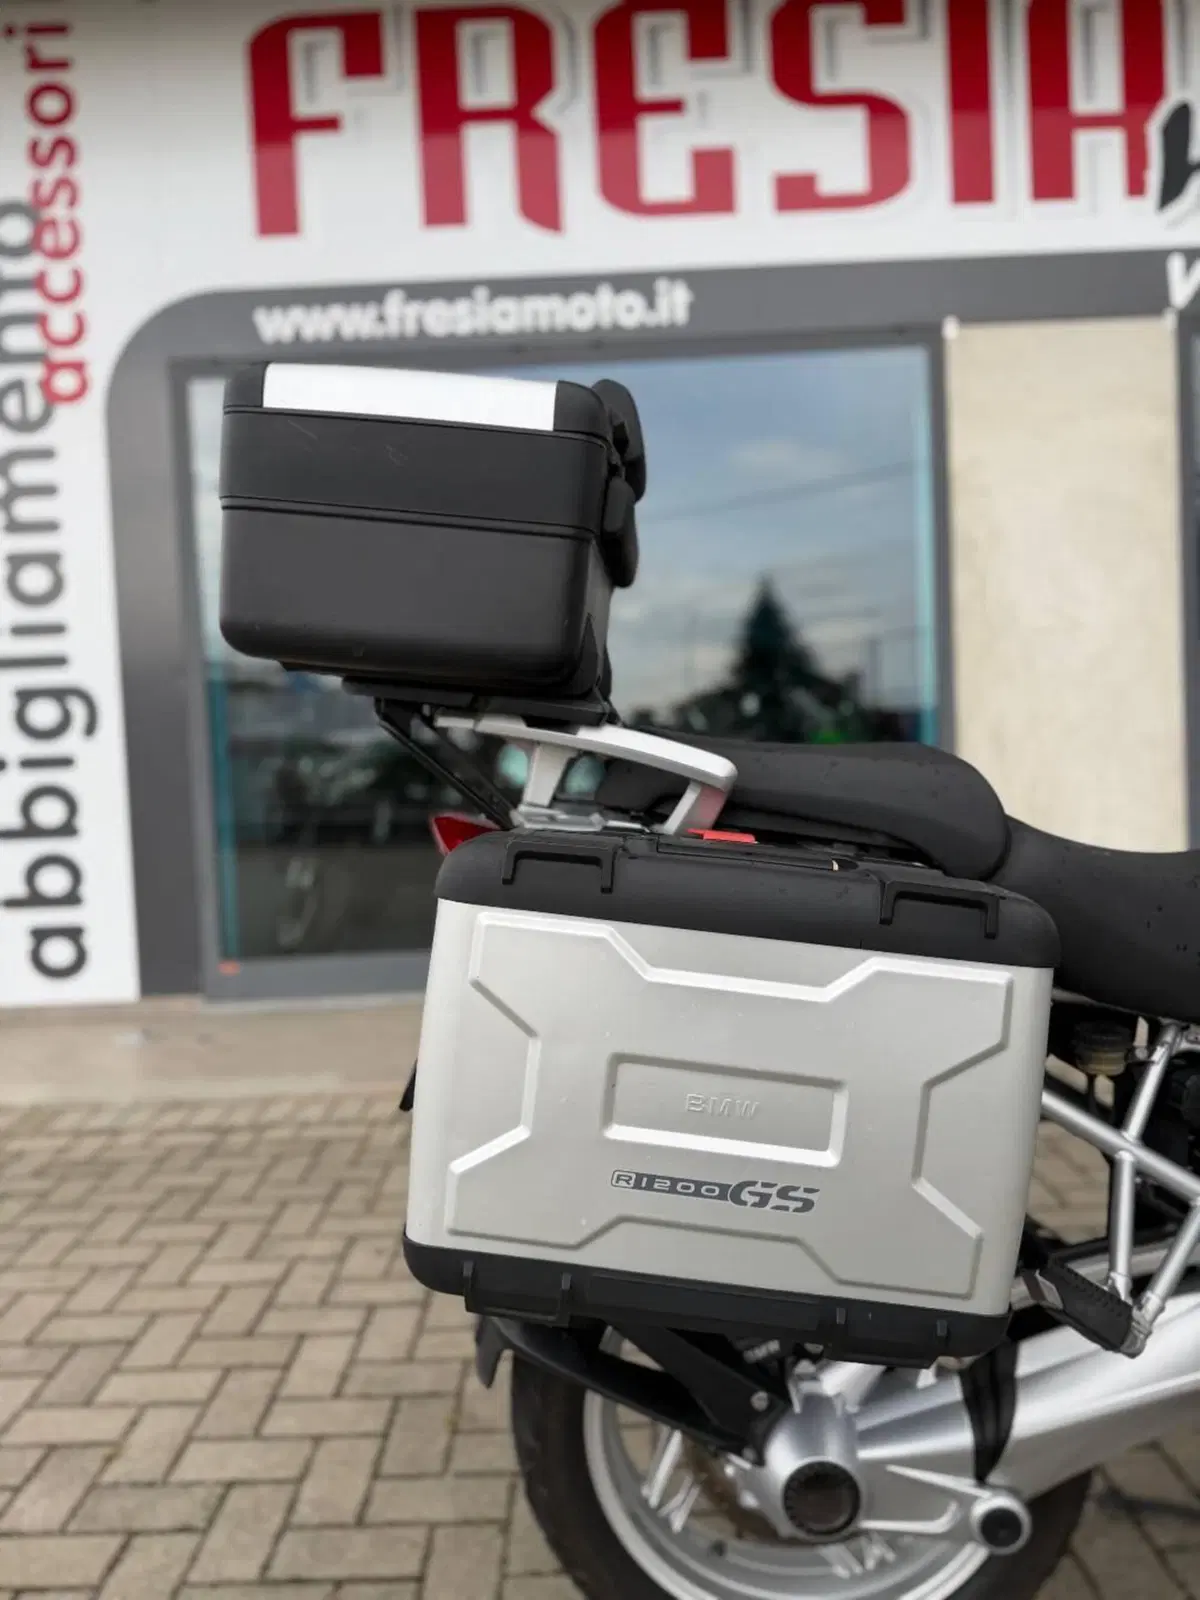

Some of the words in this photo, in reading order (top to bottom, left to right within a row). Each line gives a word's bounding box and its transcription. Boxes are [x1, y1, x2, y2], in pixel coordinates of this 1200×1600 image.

[247, 0, 1166, 236] FRESIA
[2, 22, 88, 404] accessori
[253, 277, 692, 343] www.fresiamoto.it
[683, 1092, 761, 1118] BMW
